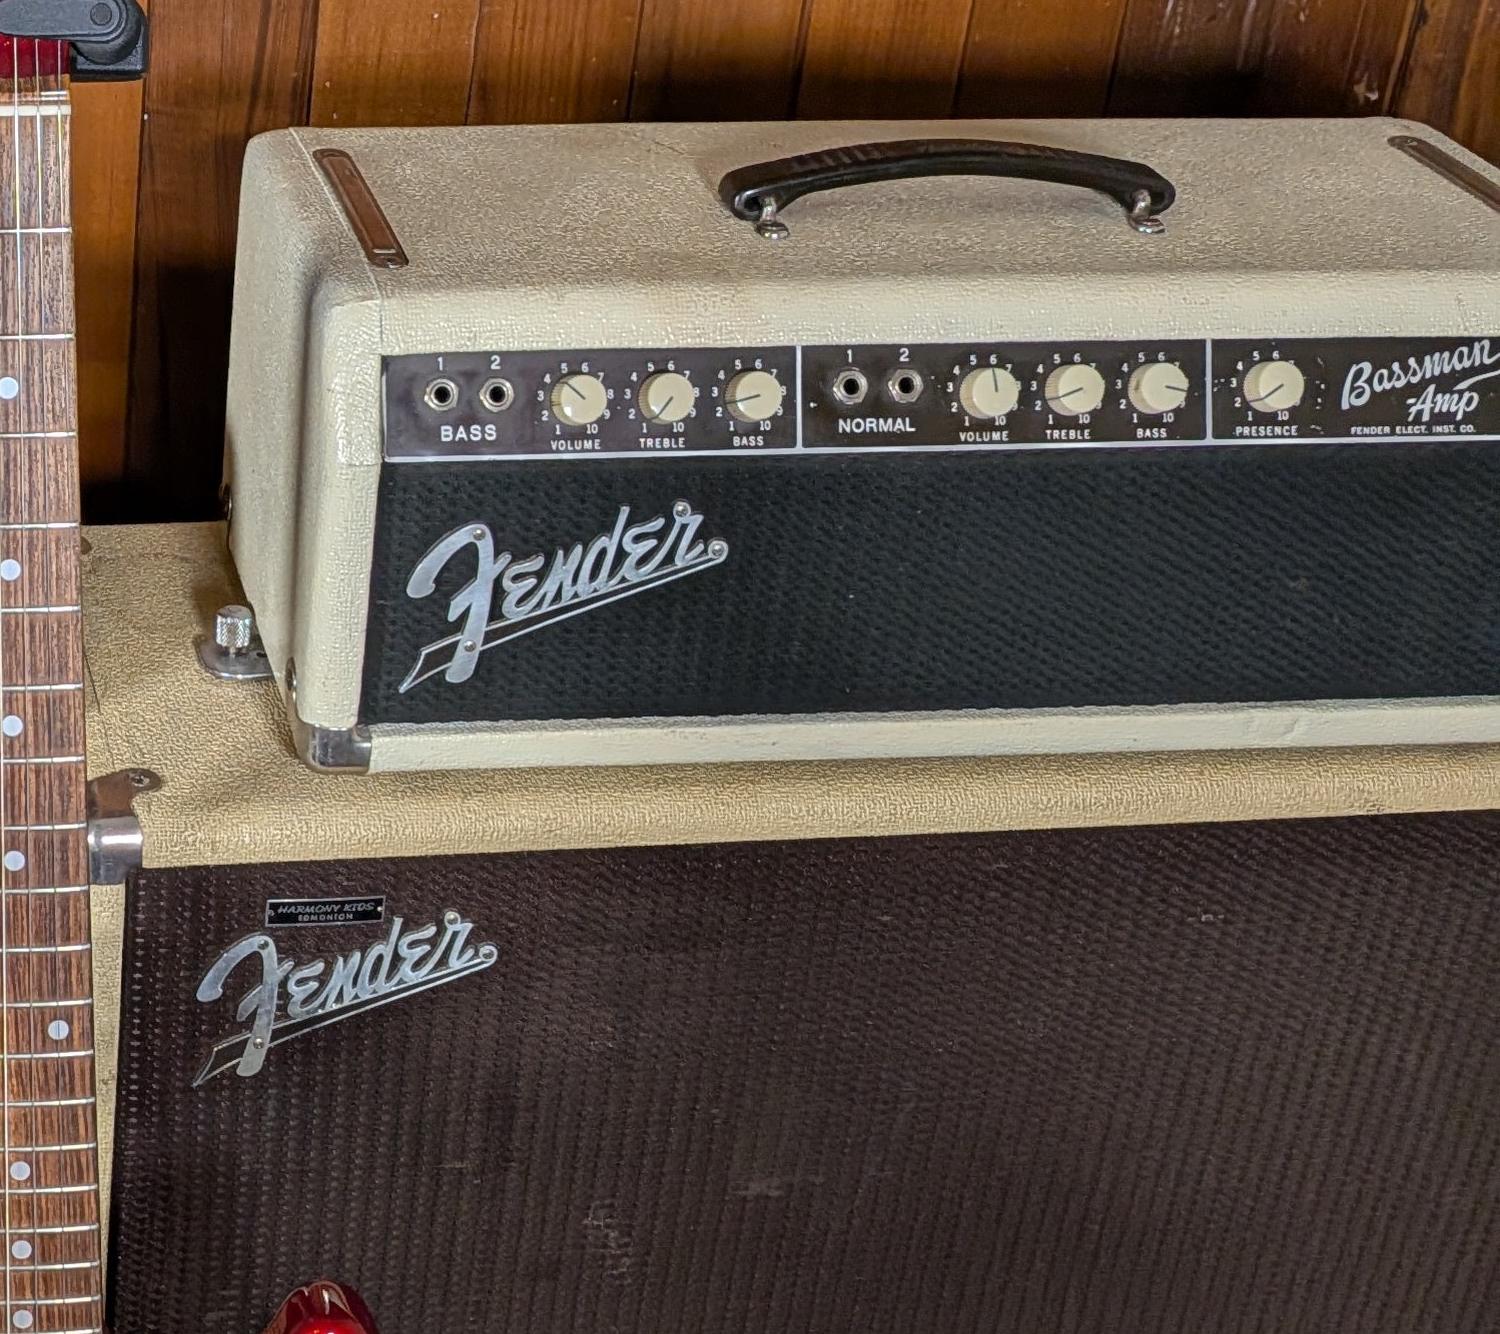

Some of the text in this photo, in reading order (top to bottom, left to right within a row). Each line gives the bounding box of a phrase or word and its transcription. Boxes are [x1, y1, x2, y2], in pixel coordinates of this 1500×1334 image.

[847, 349, 852, 363] 1
[900, 348, 909, 362] 2
[437, 357, 444, 370] 1
[490, 355, 501, 369] 2
[561, 363, 568, 373] 5
[581, 363, 588, 372] 6
[544, 373, 551, 383] 4
[1341, 339, 1500, 410] Bassman
[947, 355, 1006, 426] 1 2 3 4 5 6 10
[1030, 353, 1090, 425] 1 2 3 4 5 6 10
[1115, 352, 1174, 423] 1 2 3 4 5 6 10
[1230, 351, 1289, 421] 1 2 3 4 5 6 10
[537, 391, 544, 401] 3
[624, 361, 684, 433] 1 2 3 4 5 6 10
[712, 359, 771, 431] 1 2 3 4 5 6 10
[542, 411, 548, 420] 2
[556, 424, 561, 434] 1
[587, 424, 598, 434] 10
[838, 417, 916, 433] NORMAL
[1236, 425, 1298, 436] PRESENCE
[1351, 426, 1390, 435] FENDER
[440, 424, 497, 442] BASS
[959, 431, 1009, 441] VOLUME
[1045, 429, 1091, 440] TREBLE
[1136, 428, 1167, 439] BASS
[551, 439, 601, 451] VOLUME
[639, 438, 685, 448] TREBLE
[733, 436, 764, 447] BASS
[400, 499, 729, 693] Fender
[277, 904, 341, 914] HARMONY
[192, 909, 498, 1089] Fender
